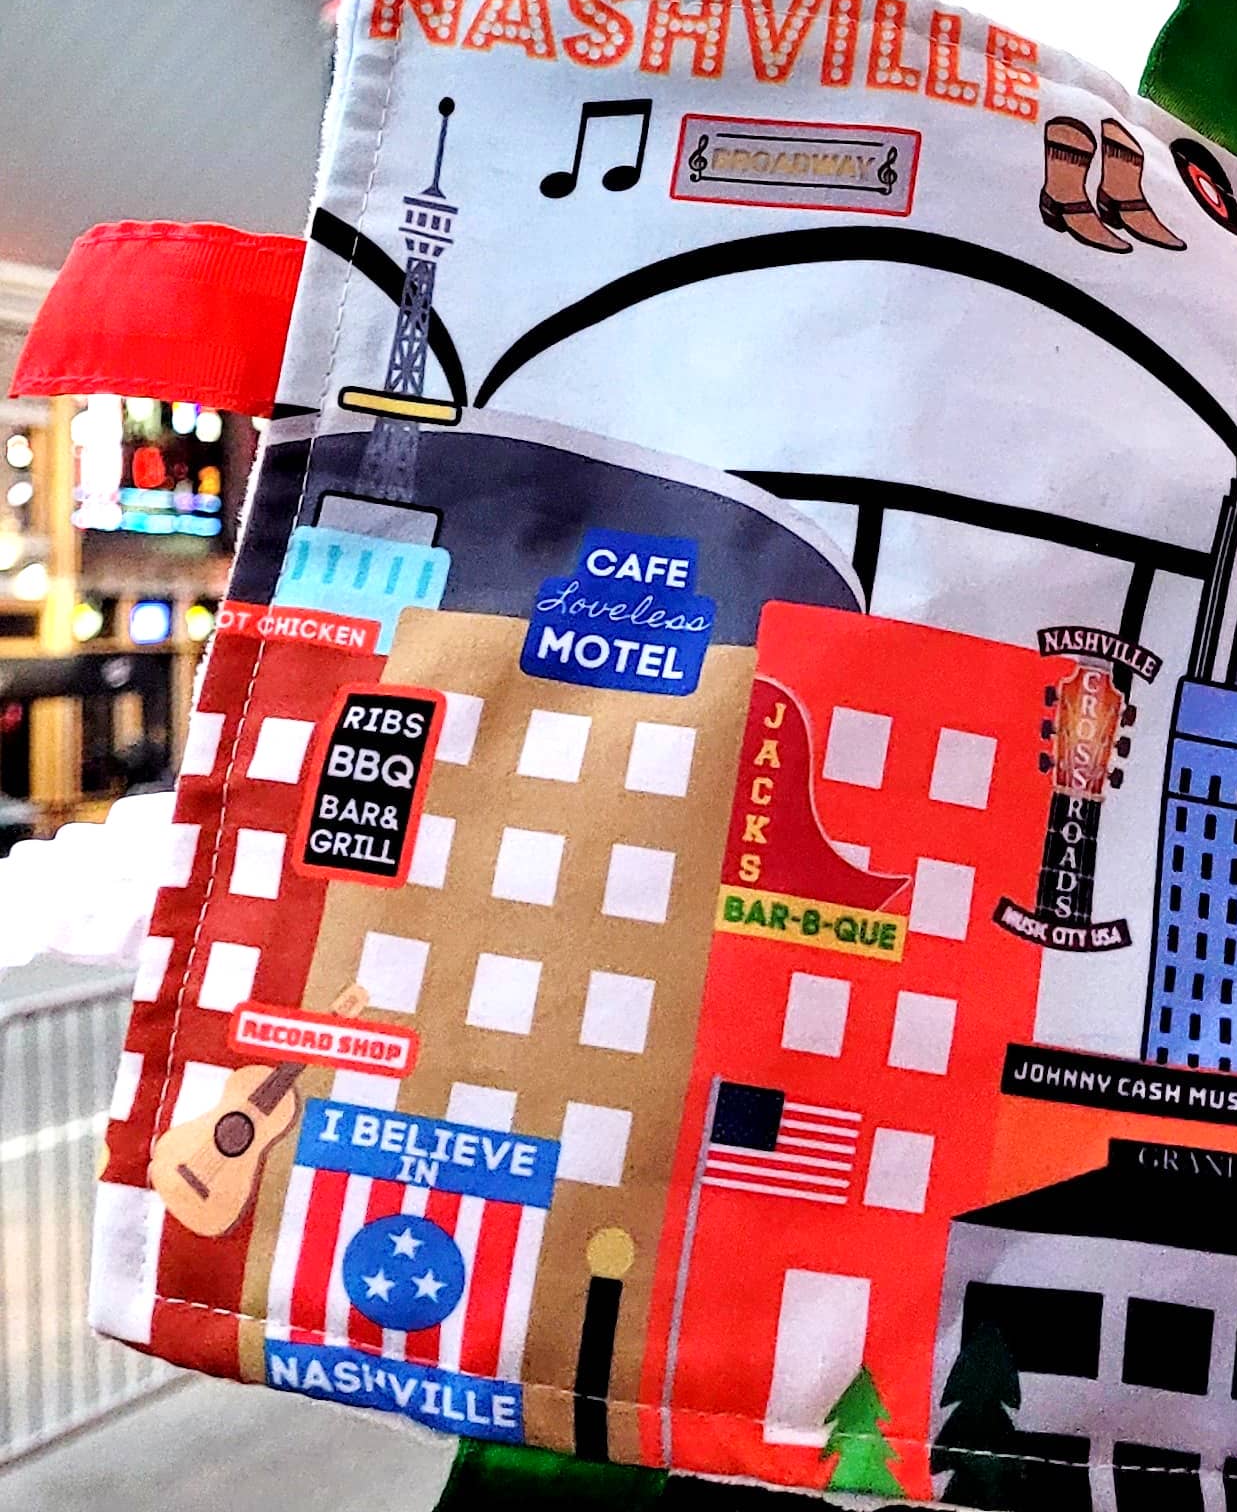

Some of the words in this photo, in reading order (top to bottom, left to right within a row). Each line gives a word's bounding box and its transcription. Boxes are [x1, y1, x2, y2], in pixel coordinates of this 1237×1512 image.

[711, 147, 876, 180] BROADWAY
[586, 549, 689, 588] CAFE
[537, 581, 711, 631] Loveless
[257, 615, 366, 648] CHICKEN
[537, 626, 684, 680] MOTEL
[1044, 630, 1157, 678] NASHVILLE
[342, 706, 426, 739] RIBS
[327, 744, 415, 790] BBQ
[319, 795, 400, 831] BAR&
[738, 702, 785, 883] JACKS
[310, 829, 396, 866] GRILL
[722, 895, 897, 951] BAR-B-QUE
[1052, 926, 1087, 947] CITY
[1091, 926, 1121, 947] USA
[242, 1019, 333, 1052] RECORD
[338, 1035, 401, 1063] SHOP
[1014, 1060, 1111, 1094] JOHNNY
[1118, 1076, 1181, 1104] CASH
[320, 1109, 344, 1142] I
[351, 1113, 537, 1178] BELIEVE
[399, 1155, 438, 1187] IN
[268, 1354, 521, 1428] NASHVILLE
